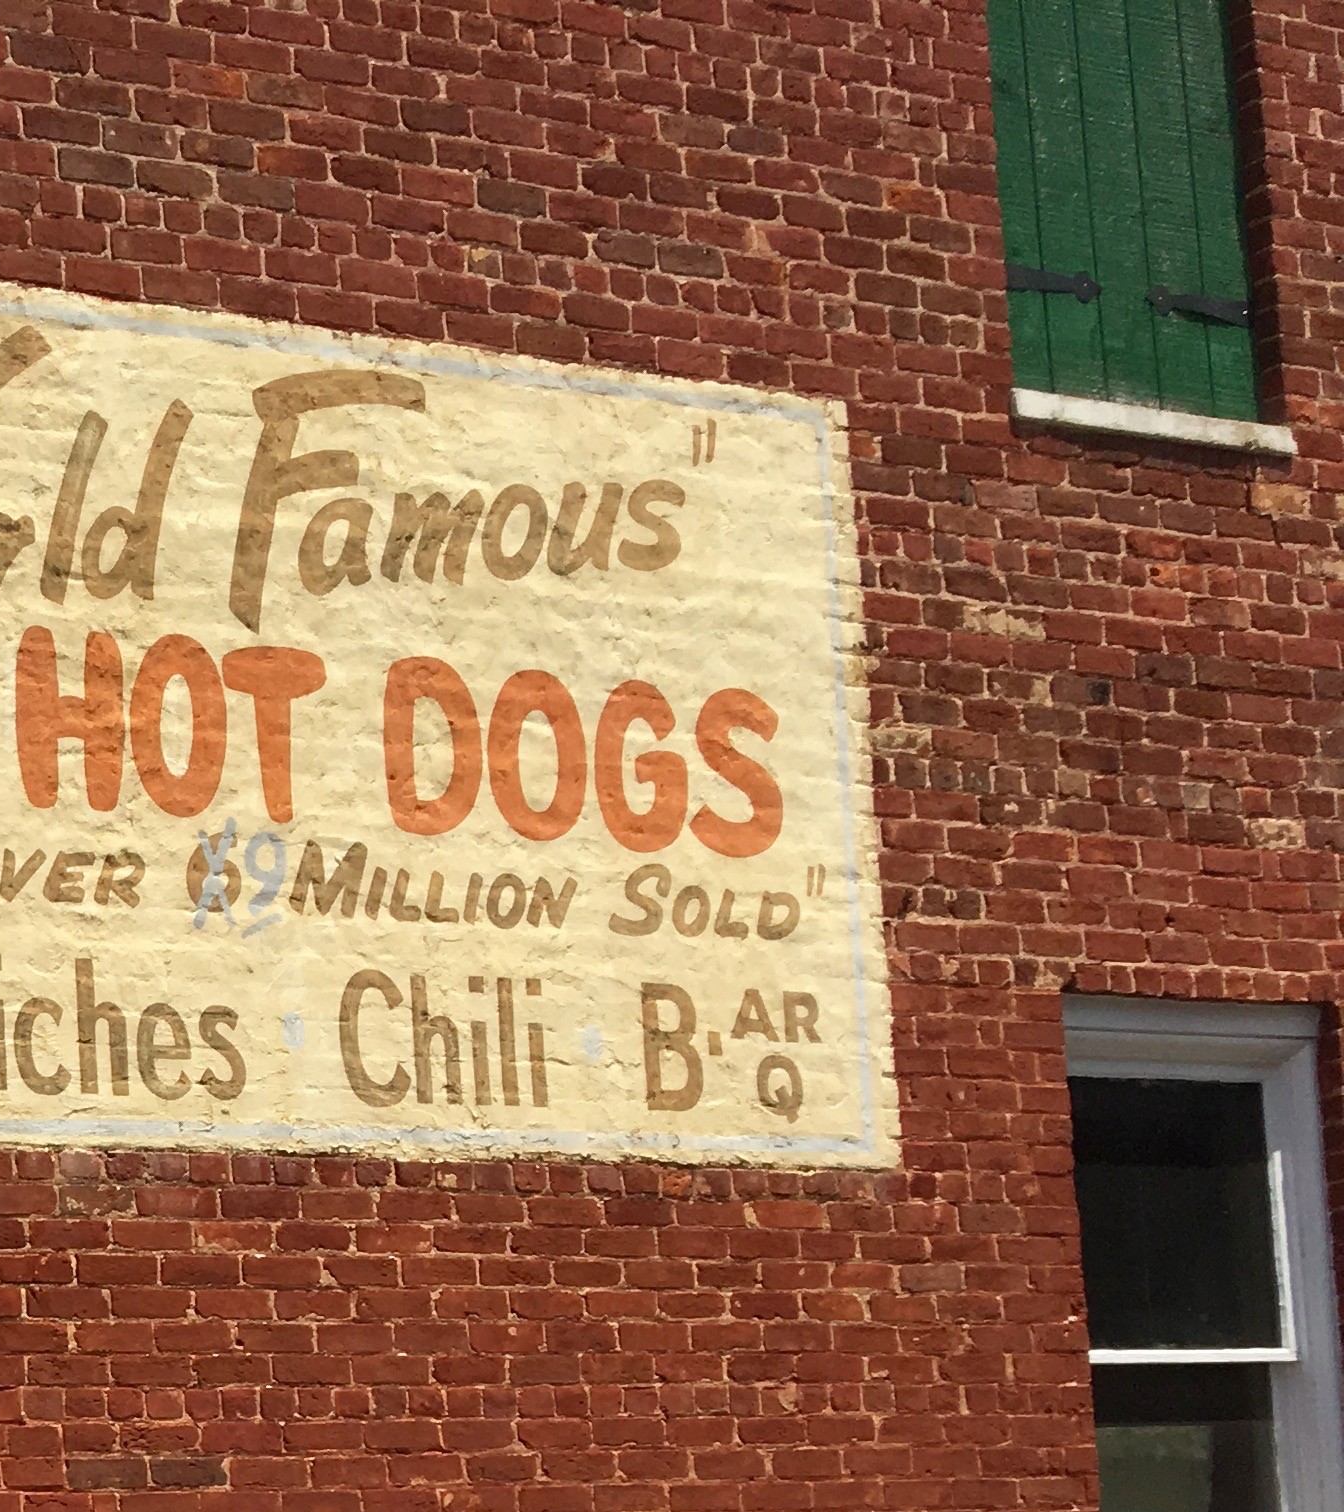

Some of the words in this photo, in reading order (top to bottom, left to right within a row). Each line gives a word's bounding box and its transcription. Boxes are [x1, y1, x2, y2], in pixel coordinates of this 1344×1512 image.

[15, 626, 327, 822] HOT
[382, 655, 783, 858] DOGS
[289, 840, 579, 930] MILLION
[337, 968, 550, 1109] Chili
